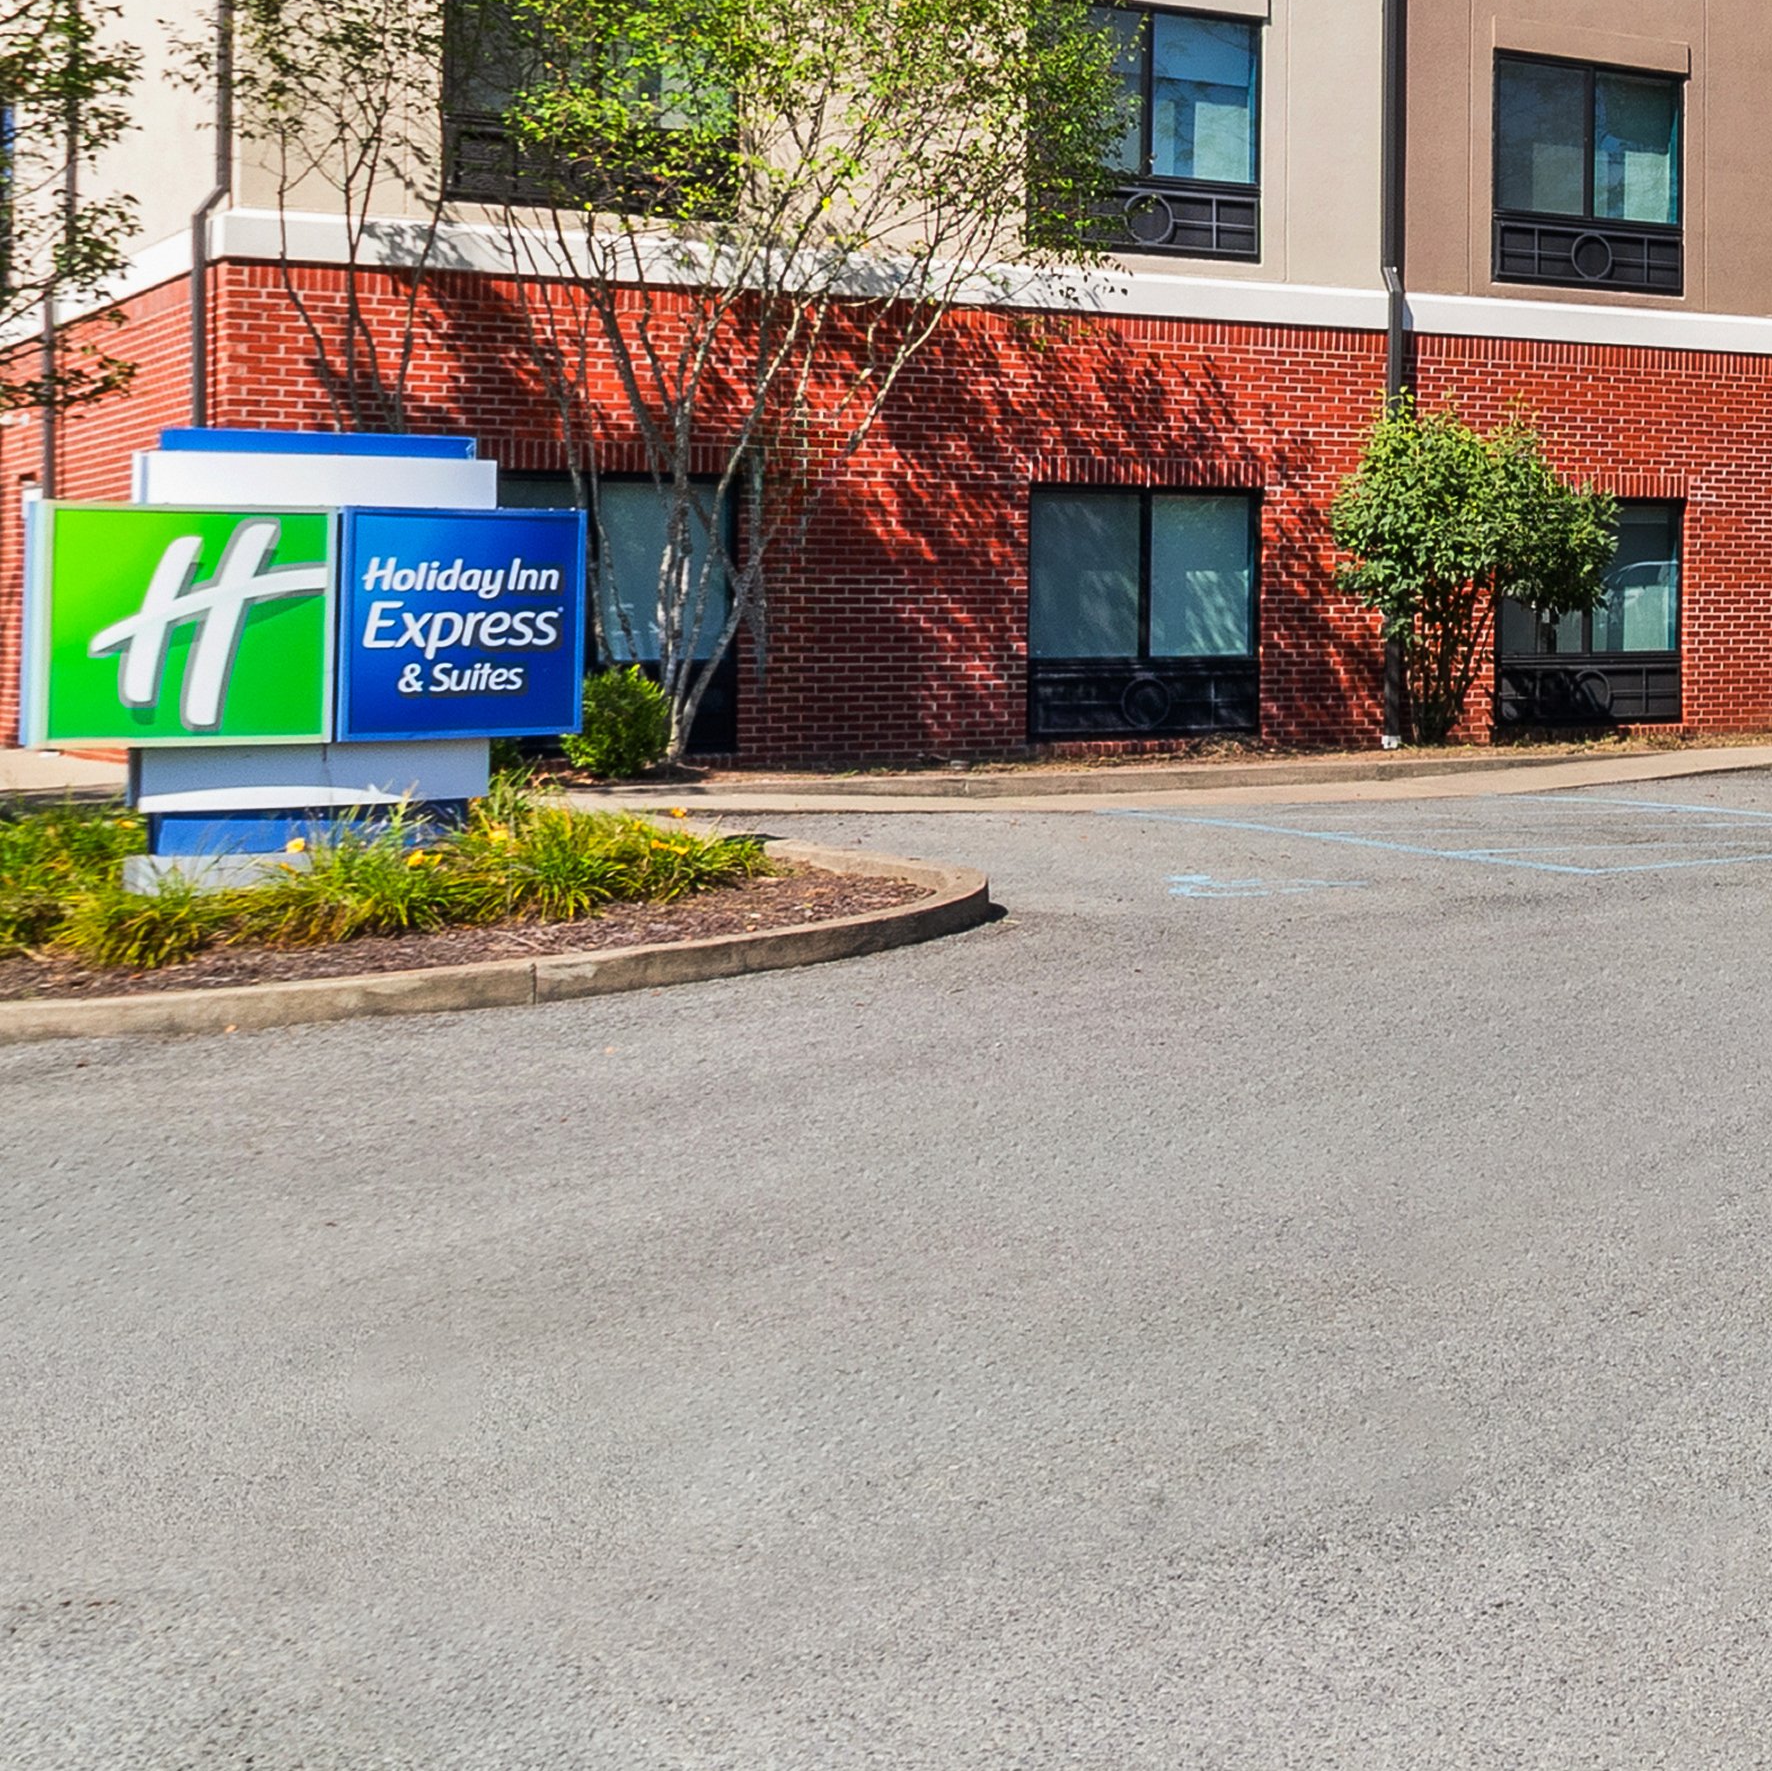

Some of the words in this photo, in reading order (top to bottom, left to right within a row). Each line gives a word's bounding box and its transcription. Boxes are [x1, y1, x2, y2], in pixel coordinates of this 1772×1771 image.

[362, 556, 505, 599] Holiday
[507, 557, 560, 591] Inn
[362, 600, 560, 660] Express
[397, 663, 424, 693] &
[429, 662, 524, 692] Suites
